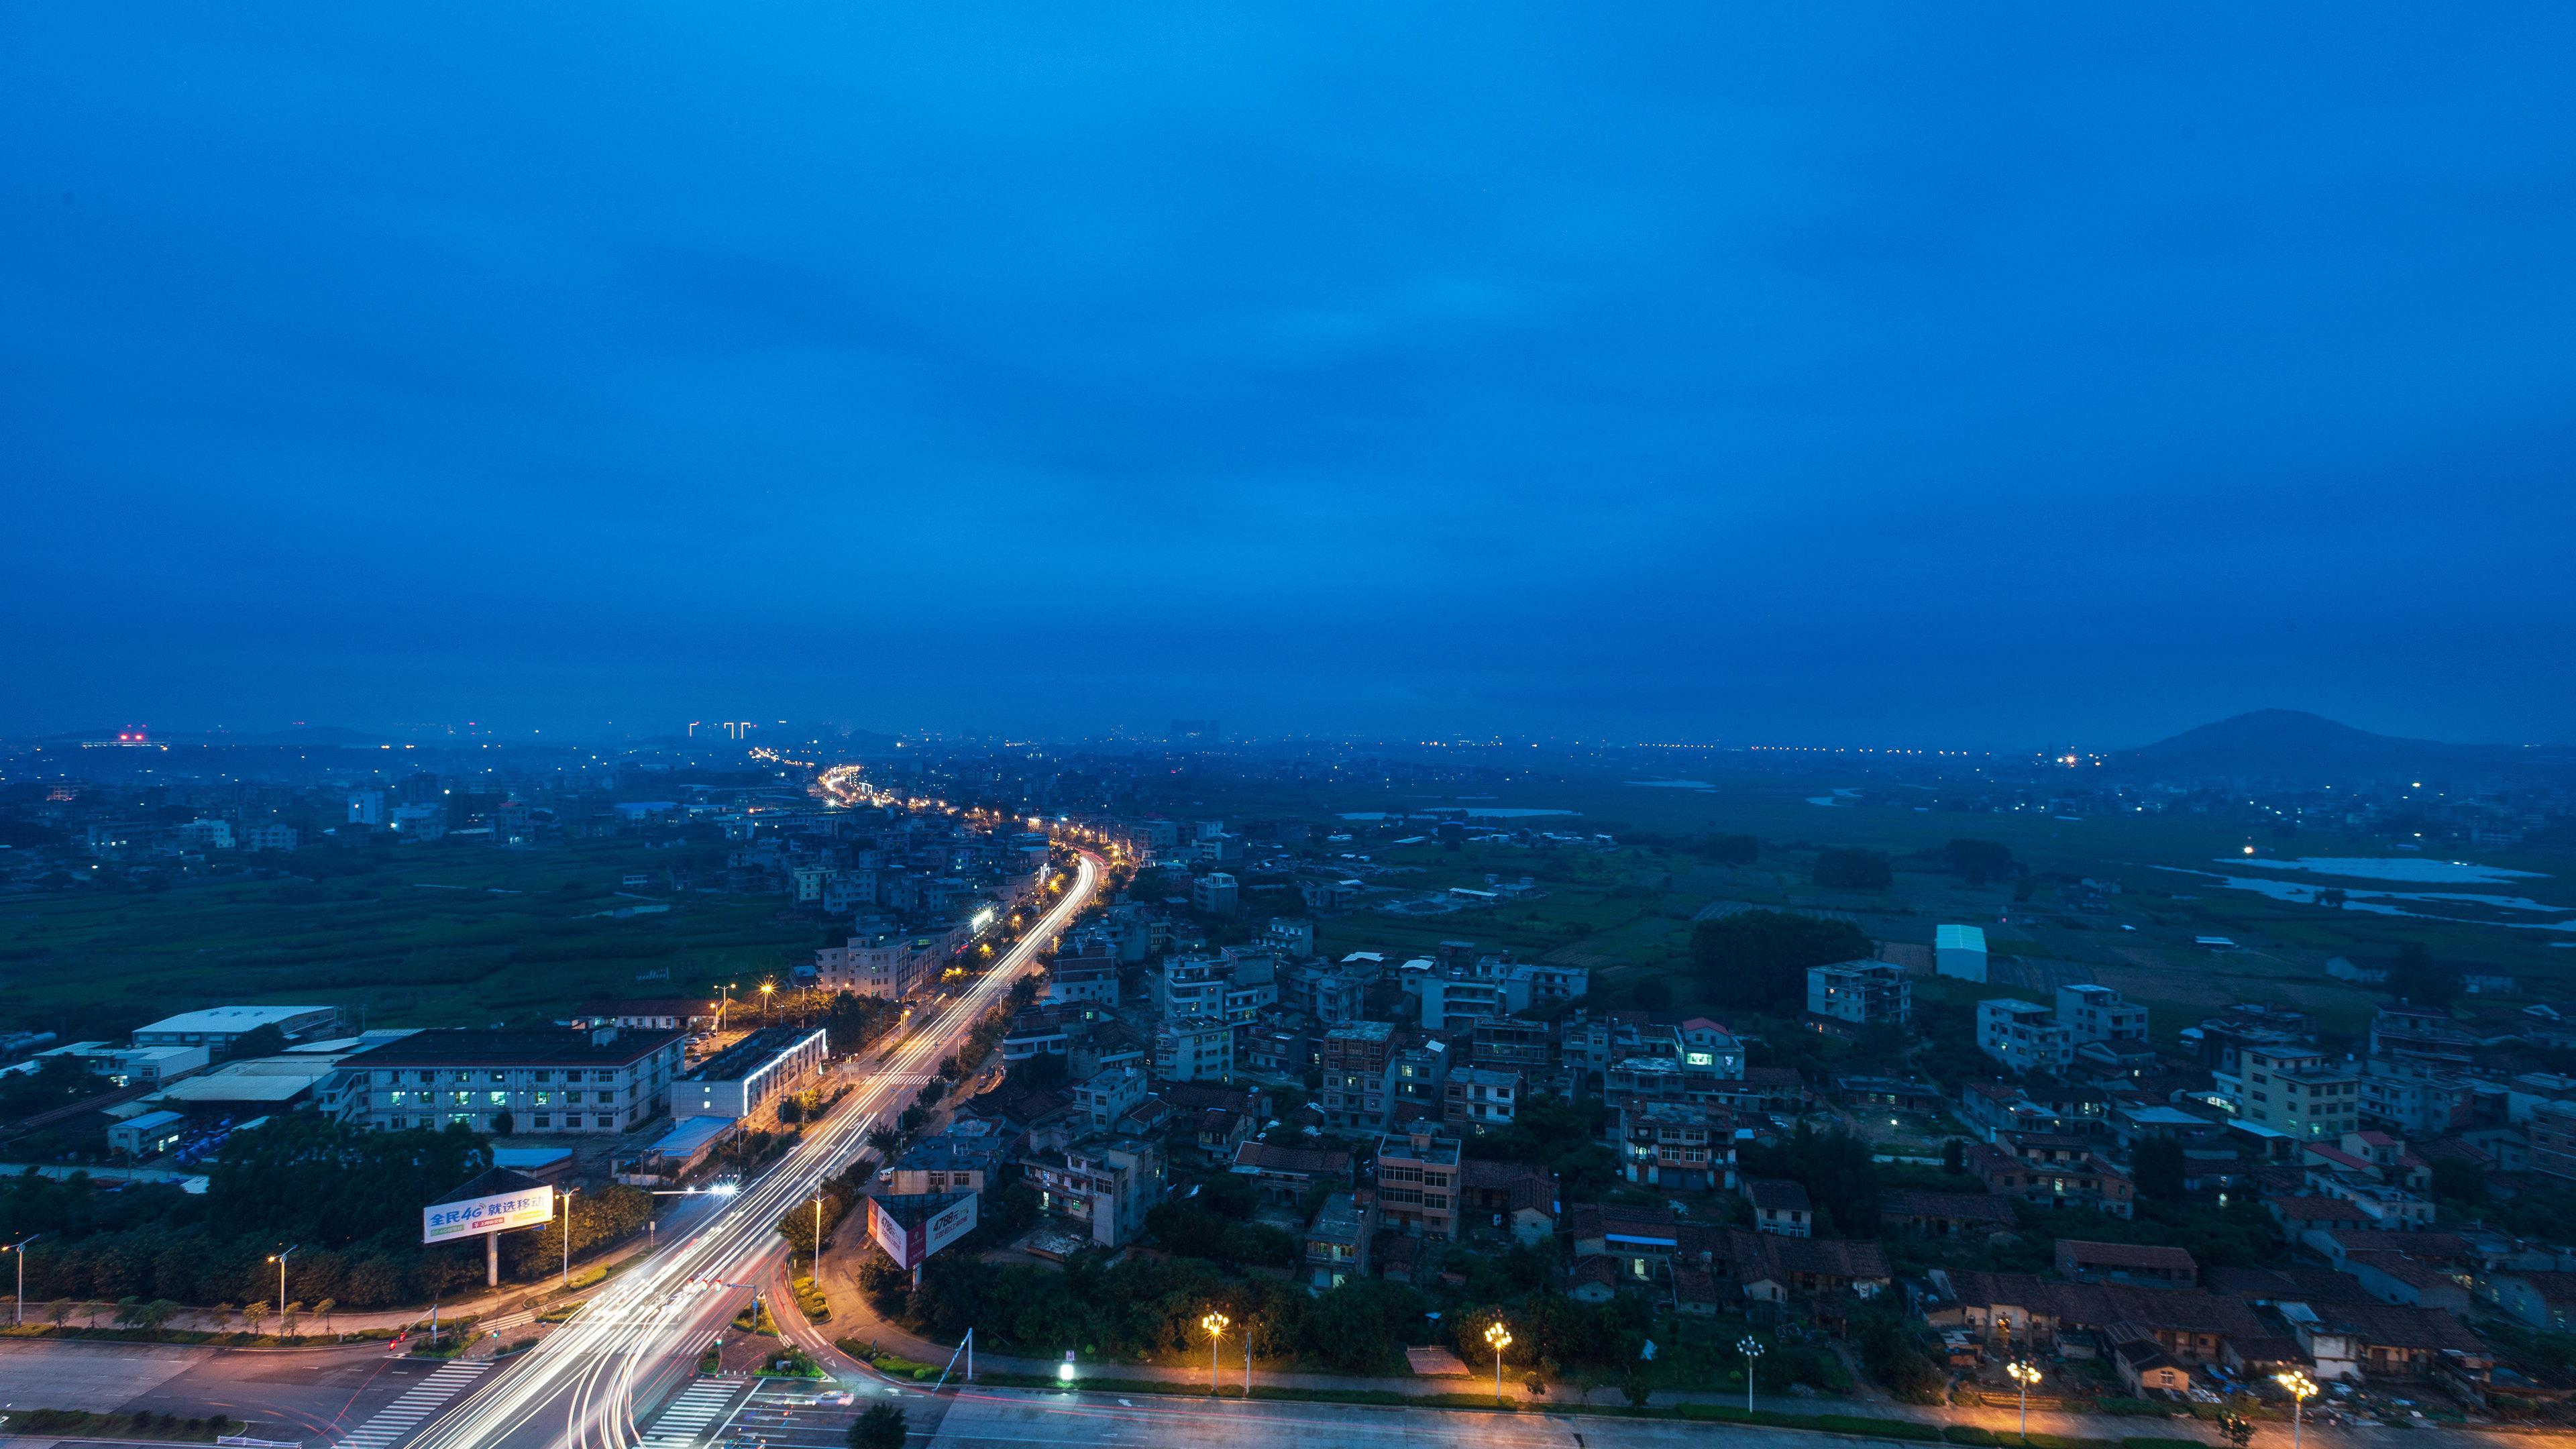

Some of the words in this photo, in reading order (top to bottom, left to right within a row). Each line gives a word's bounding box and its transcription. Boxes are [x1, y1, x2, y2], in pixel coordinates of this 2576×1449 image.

[430, 1207, 482, 1226] 全民4G
[488, 1195, 545, 1216] 就选移动
[933, 1210, 959, 1232] 4788元
